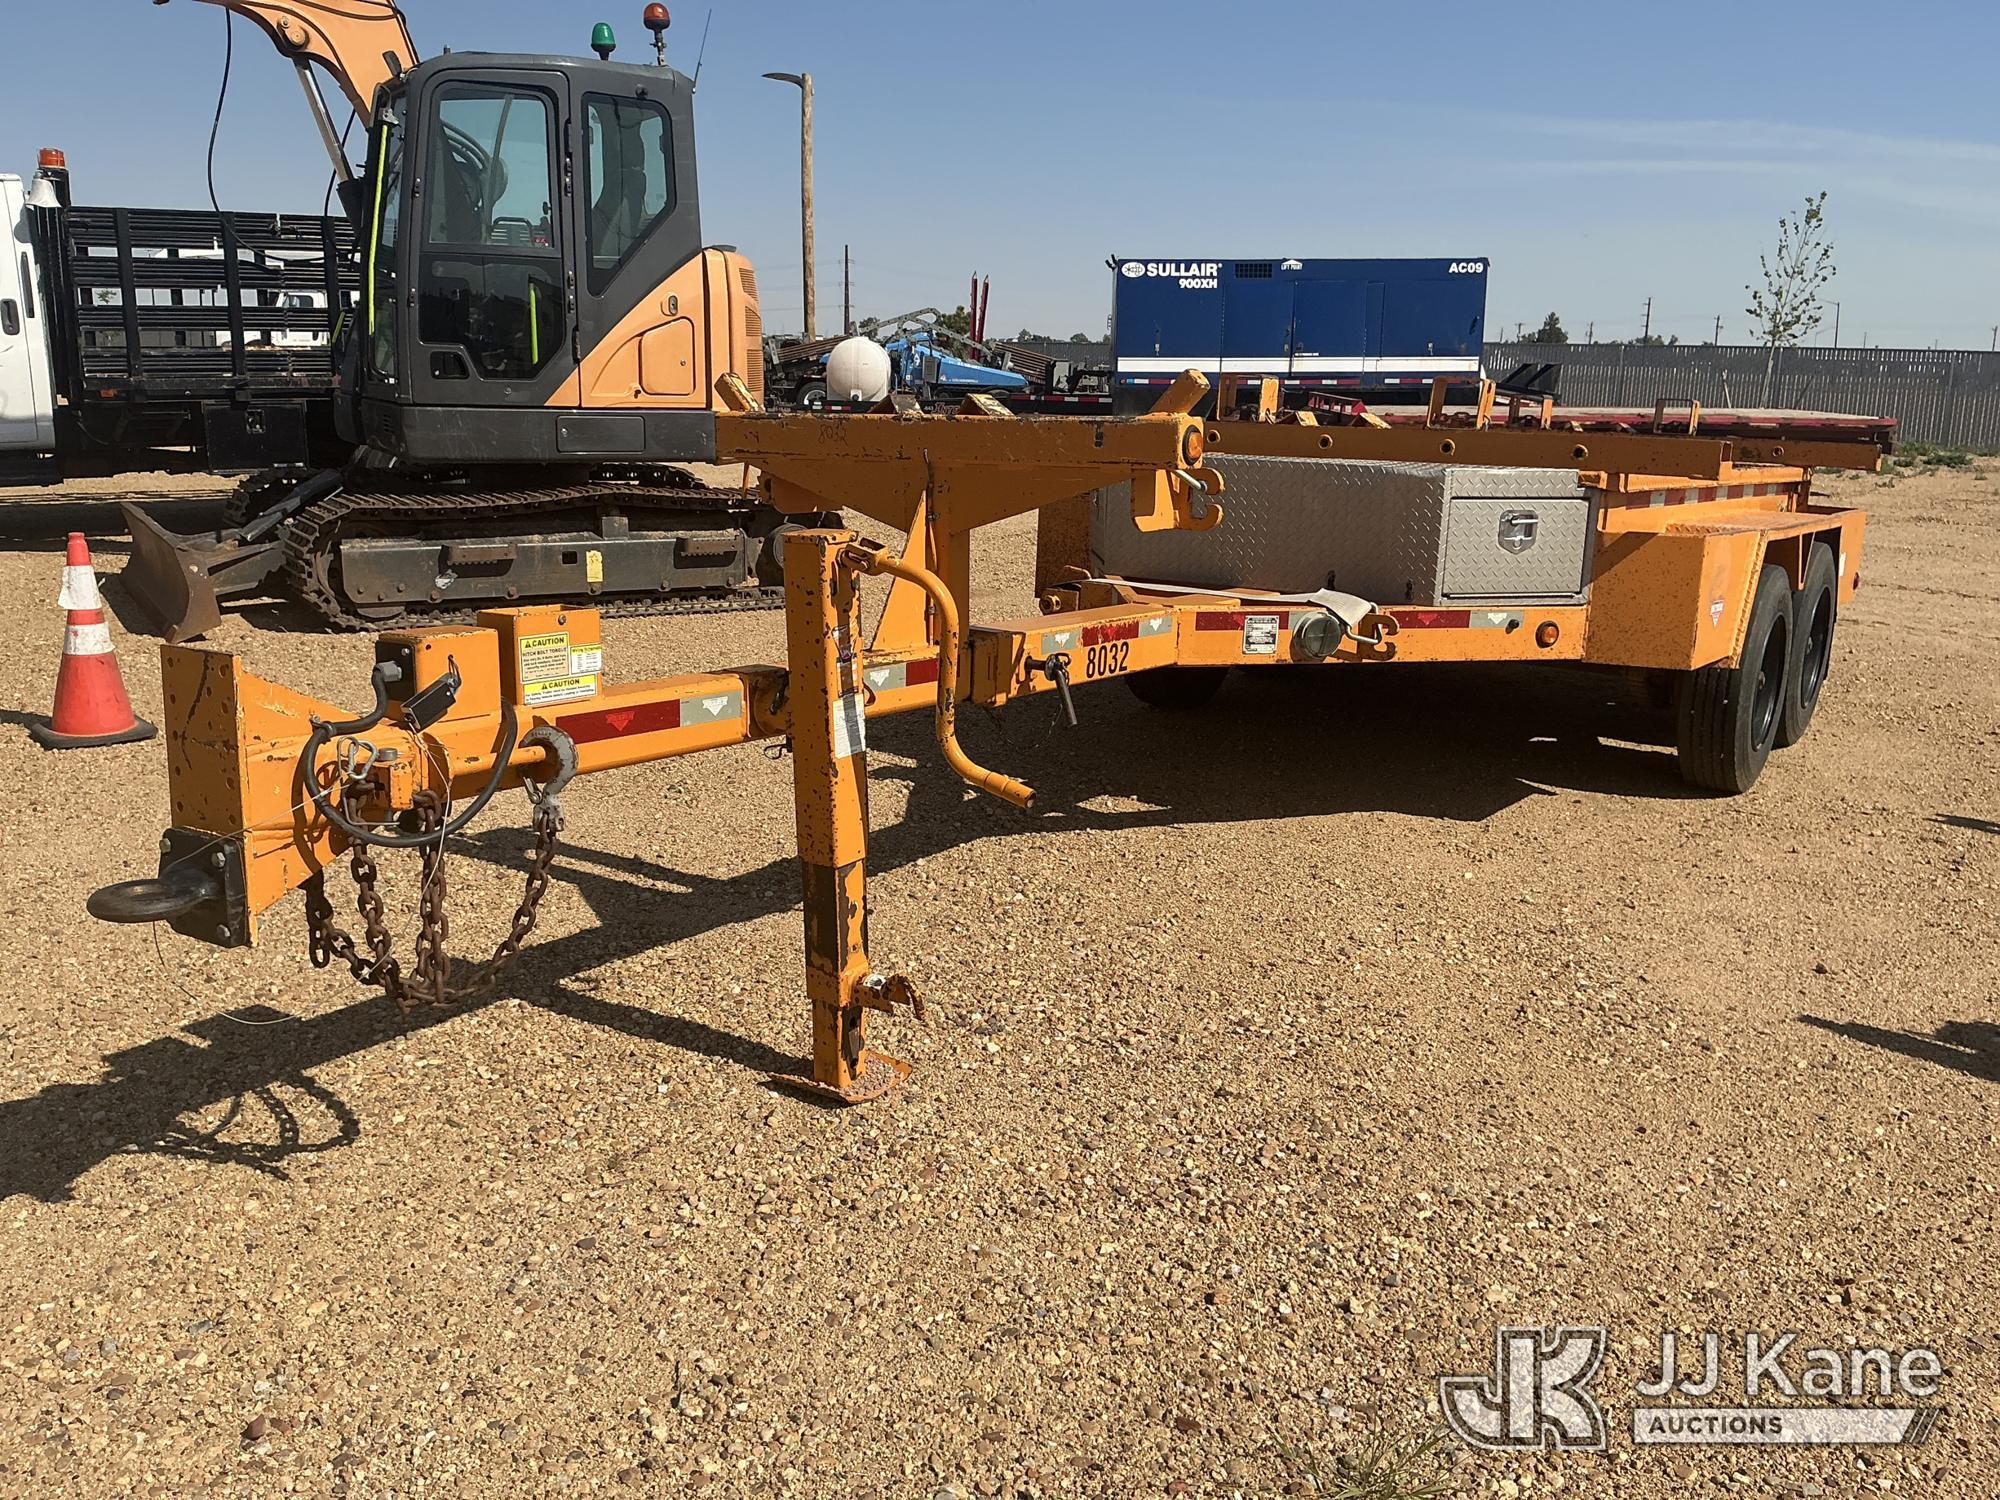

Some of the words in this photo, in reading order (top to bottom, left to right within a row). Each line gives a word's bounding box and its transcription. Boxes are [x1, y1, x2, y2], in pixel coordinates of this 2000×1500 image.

[1146, 263, 1217, 277] SULLAIR
[1448, 262, 1484, 273] AC09
[1178, 278, 1218, 289] 900XH
[532, 637, 565, 647] CAUTION
[1086, 641, 1129, 678] 8032
[549, 679, 580, 688] CAUTION
